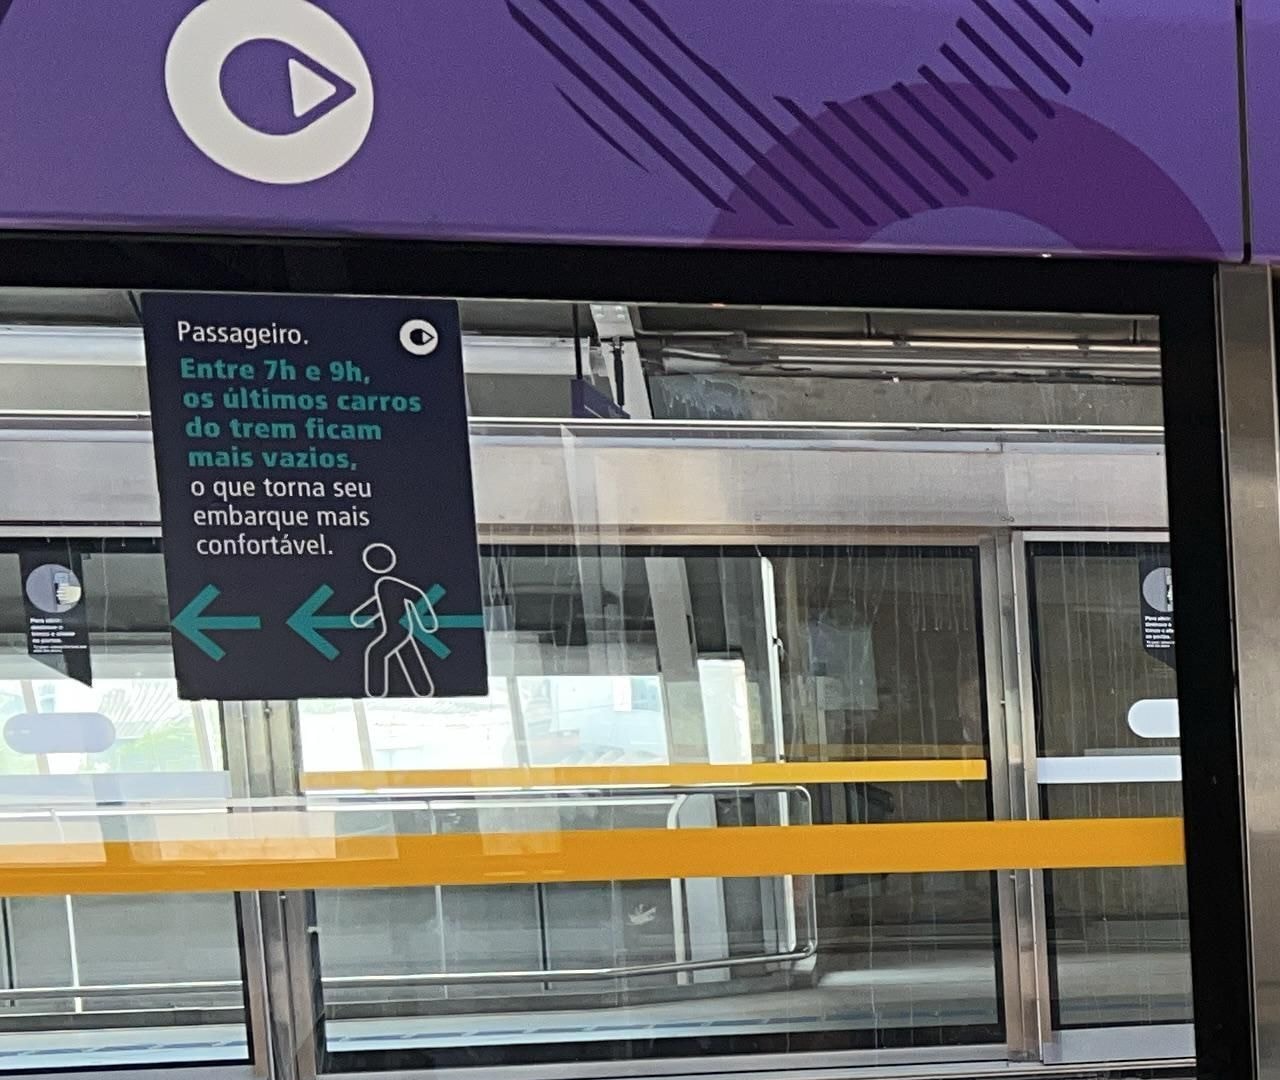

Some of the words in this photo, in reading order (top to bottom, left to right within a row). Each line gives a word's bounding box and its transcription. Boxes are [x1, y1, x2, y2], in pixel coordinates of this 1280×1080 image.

[177, 321, 309, 349] Passageiro.
[180, 359, 255, 381] Entre
[264, 359, 296, 382] 7h
[305, 365, 321, 382] e
[329, 360, 371, 386] 9h,
[183, 392, 214, 410] os
[223, 387, 328, 412] últimos
[336, 393, 422, 413] carros
[186, 417, 221, 439] do
[229, 419, 296, 440] trem
[304, 418, 382, 441] ficam
[188, 446, 254, 468] mais
[261, 447, 358, 472] vazios,
[191, 481, 205, 498] o
[212, 480, 256, 503] que
[263, 478, 326, 499] torna
[333, 481, 372, 499] seu
[193, 506, 308, 532] embarque
[316, 507, 371, 528] mais
[196, 533, 334, 556] confortável.
